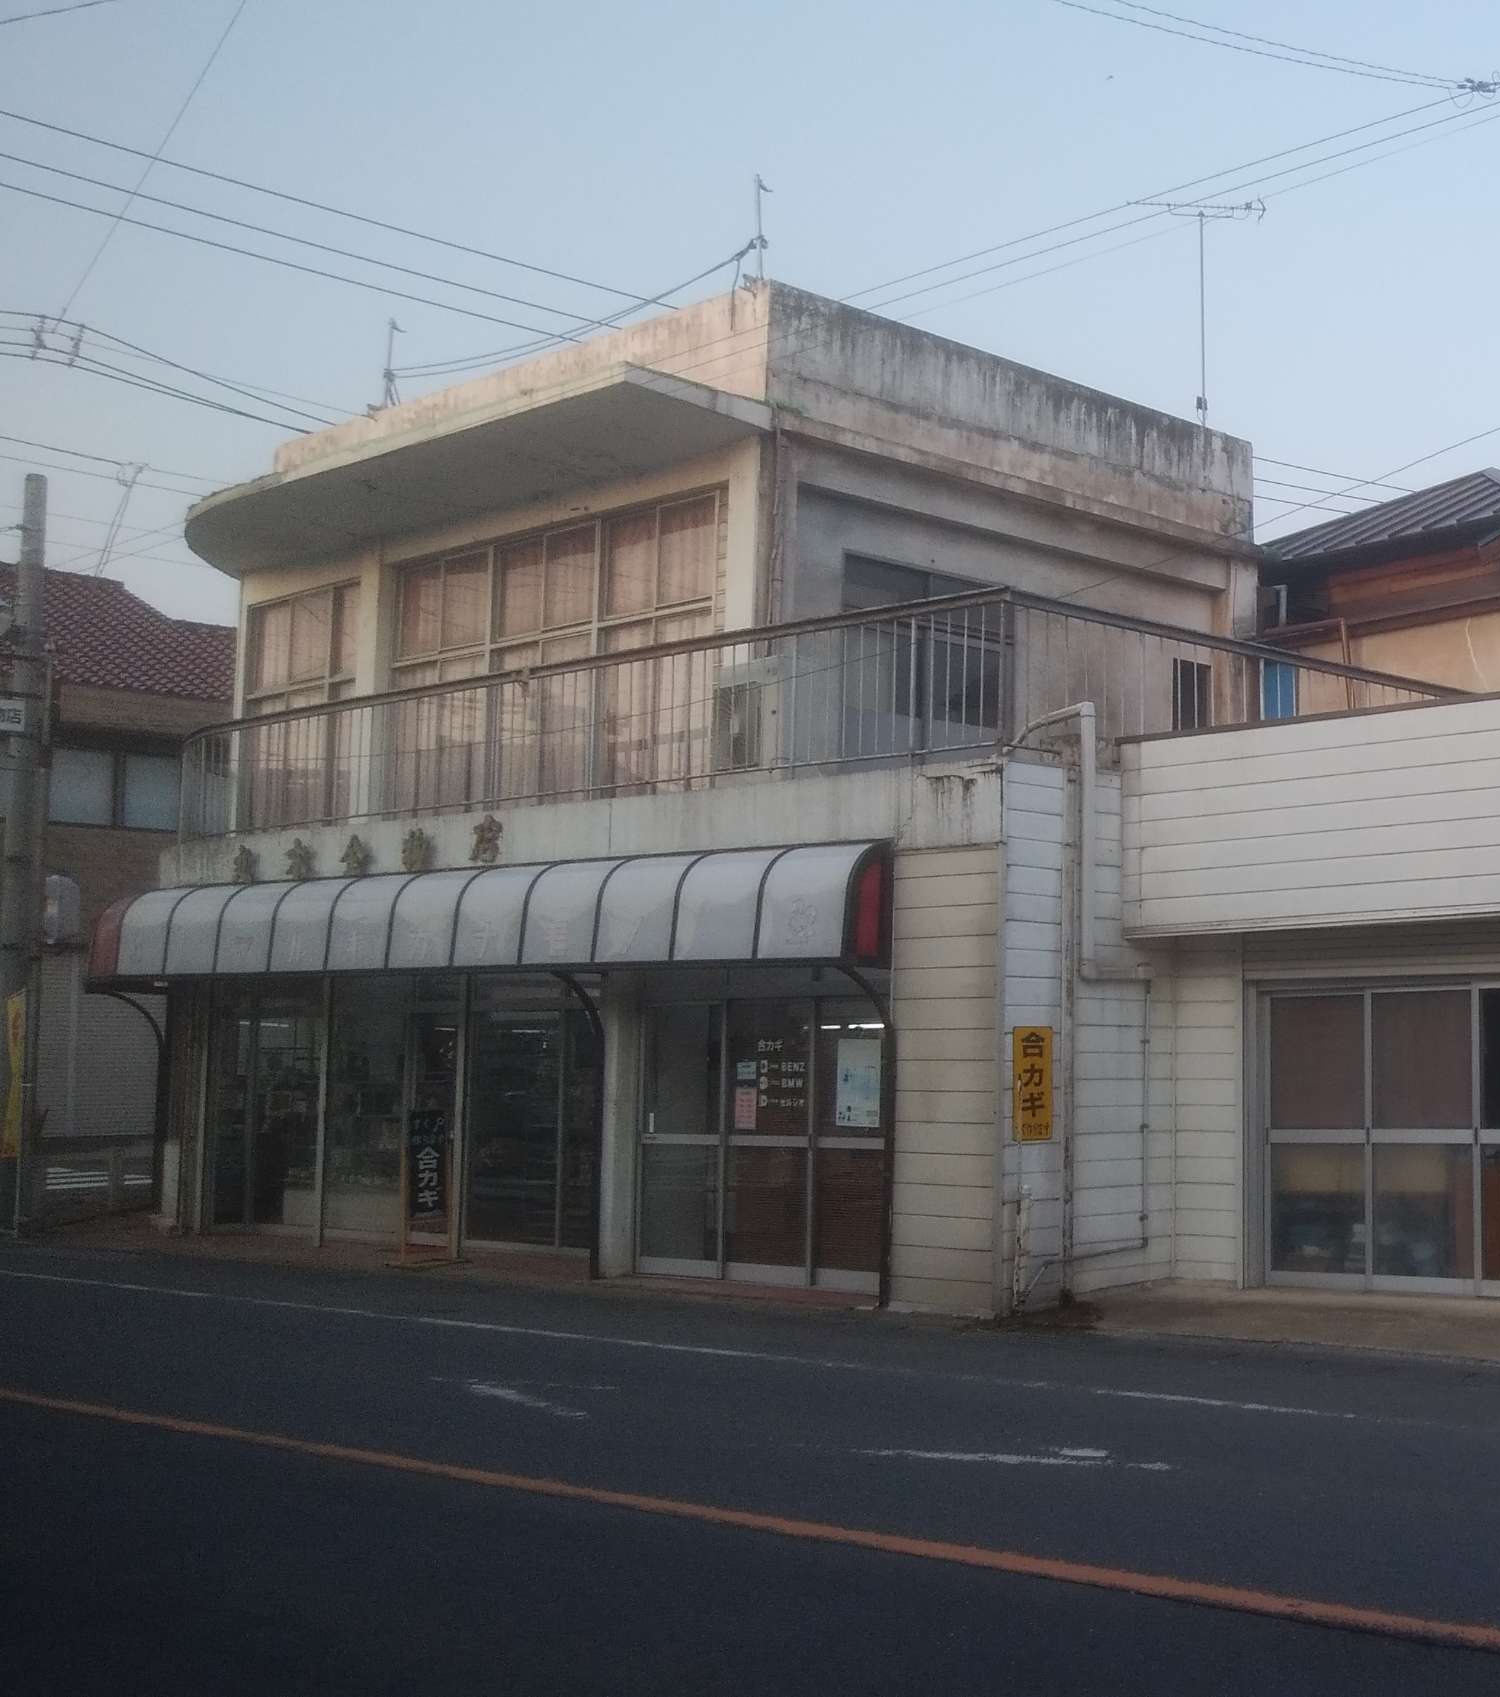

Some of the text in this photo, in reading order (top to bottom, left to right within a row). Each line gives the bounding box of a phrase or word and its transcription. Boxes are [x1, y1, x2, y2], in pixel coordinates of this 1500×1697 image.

[758, 1039, 784, 1052] 合カギ
[781, 1062, 806, 1072] BENZ
[1021, 1031, 1045, 1118] 合カギ
[781, 1078, 803, 1089] BMW
[416, 1146, 443, 1208] 合カギ
